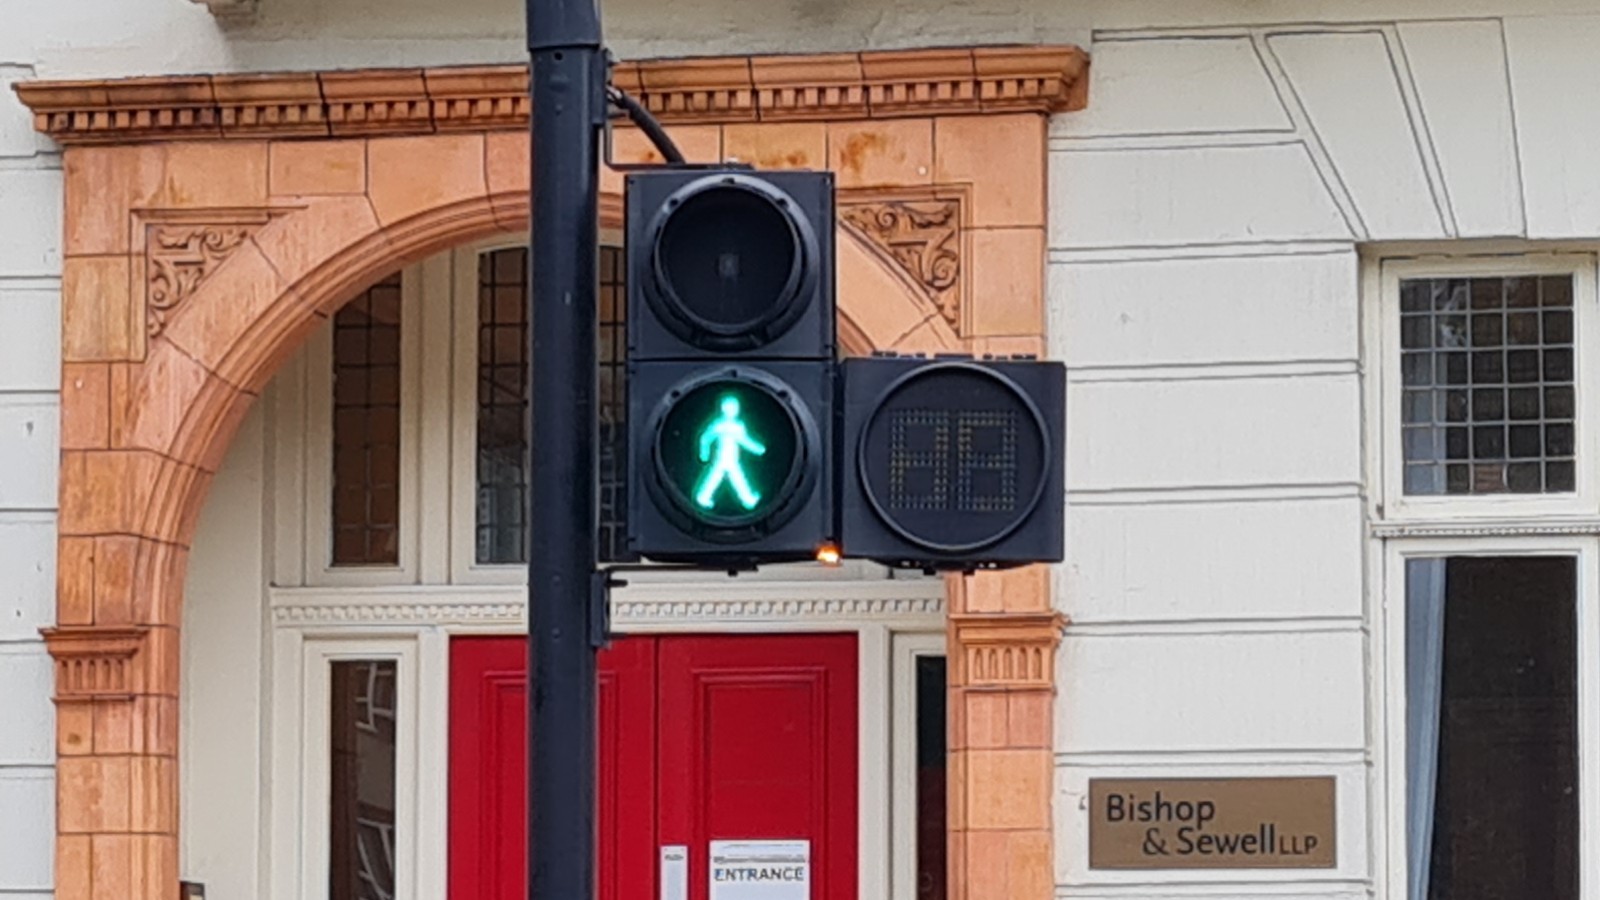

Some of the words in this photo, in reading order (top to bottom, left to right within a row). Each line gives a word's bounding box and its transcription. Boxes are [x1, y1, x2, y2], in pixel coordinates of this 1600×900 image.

[1106, 791, 1215, 830] Bishop
[1143, 827, 1170, 856] &
[1177, 823, 1275, 855] Sewell
[1279, 835, 1318, 856] LLP
[714, 866, 804, 881] ENTRANCE
